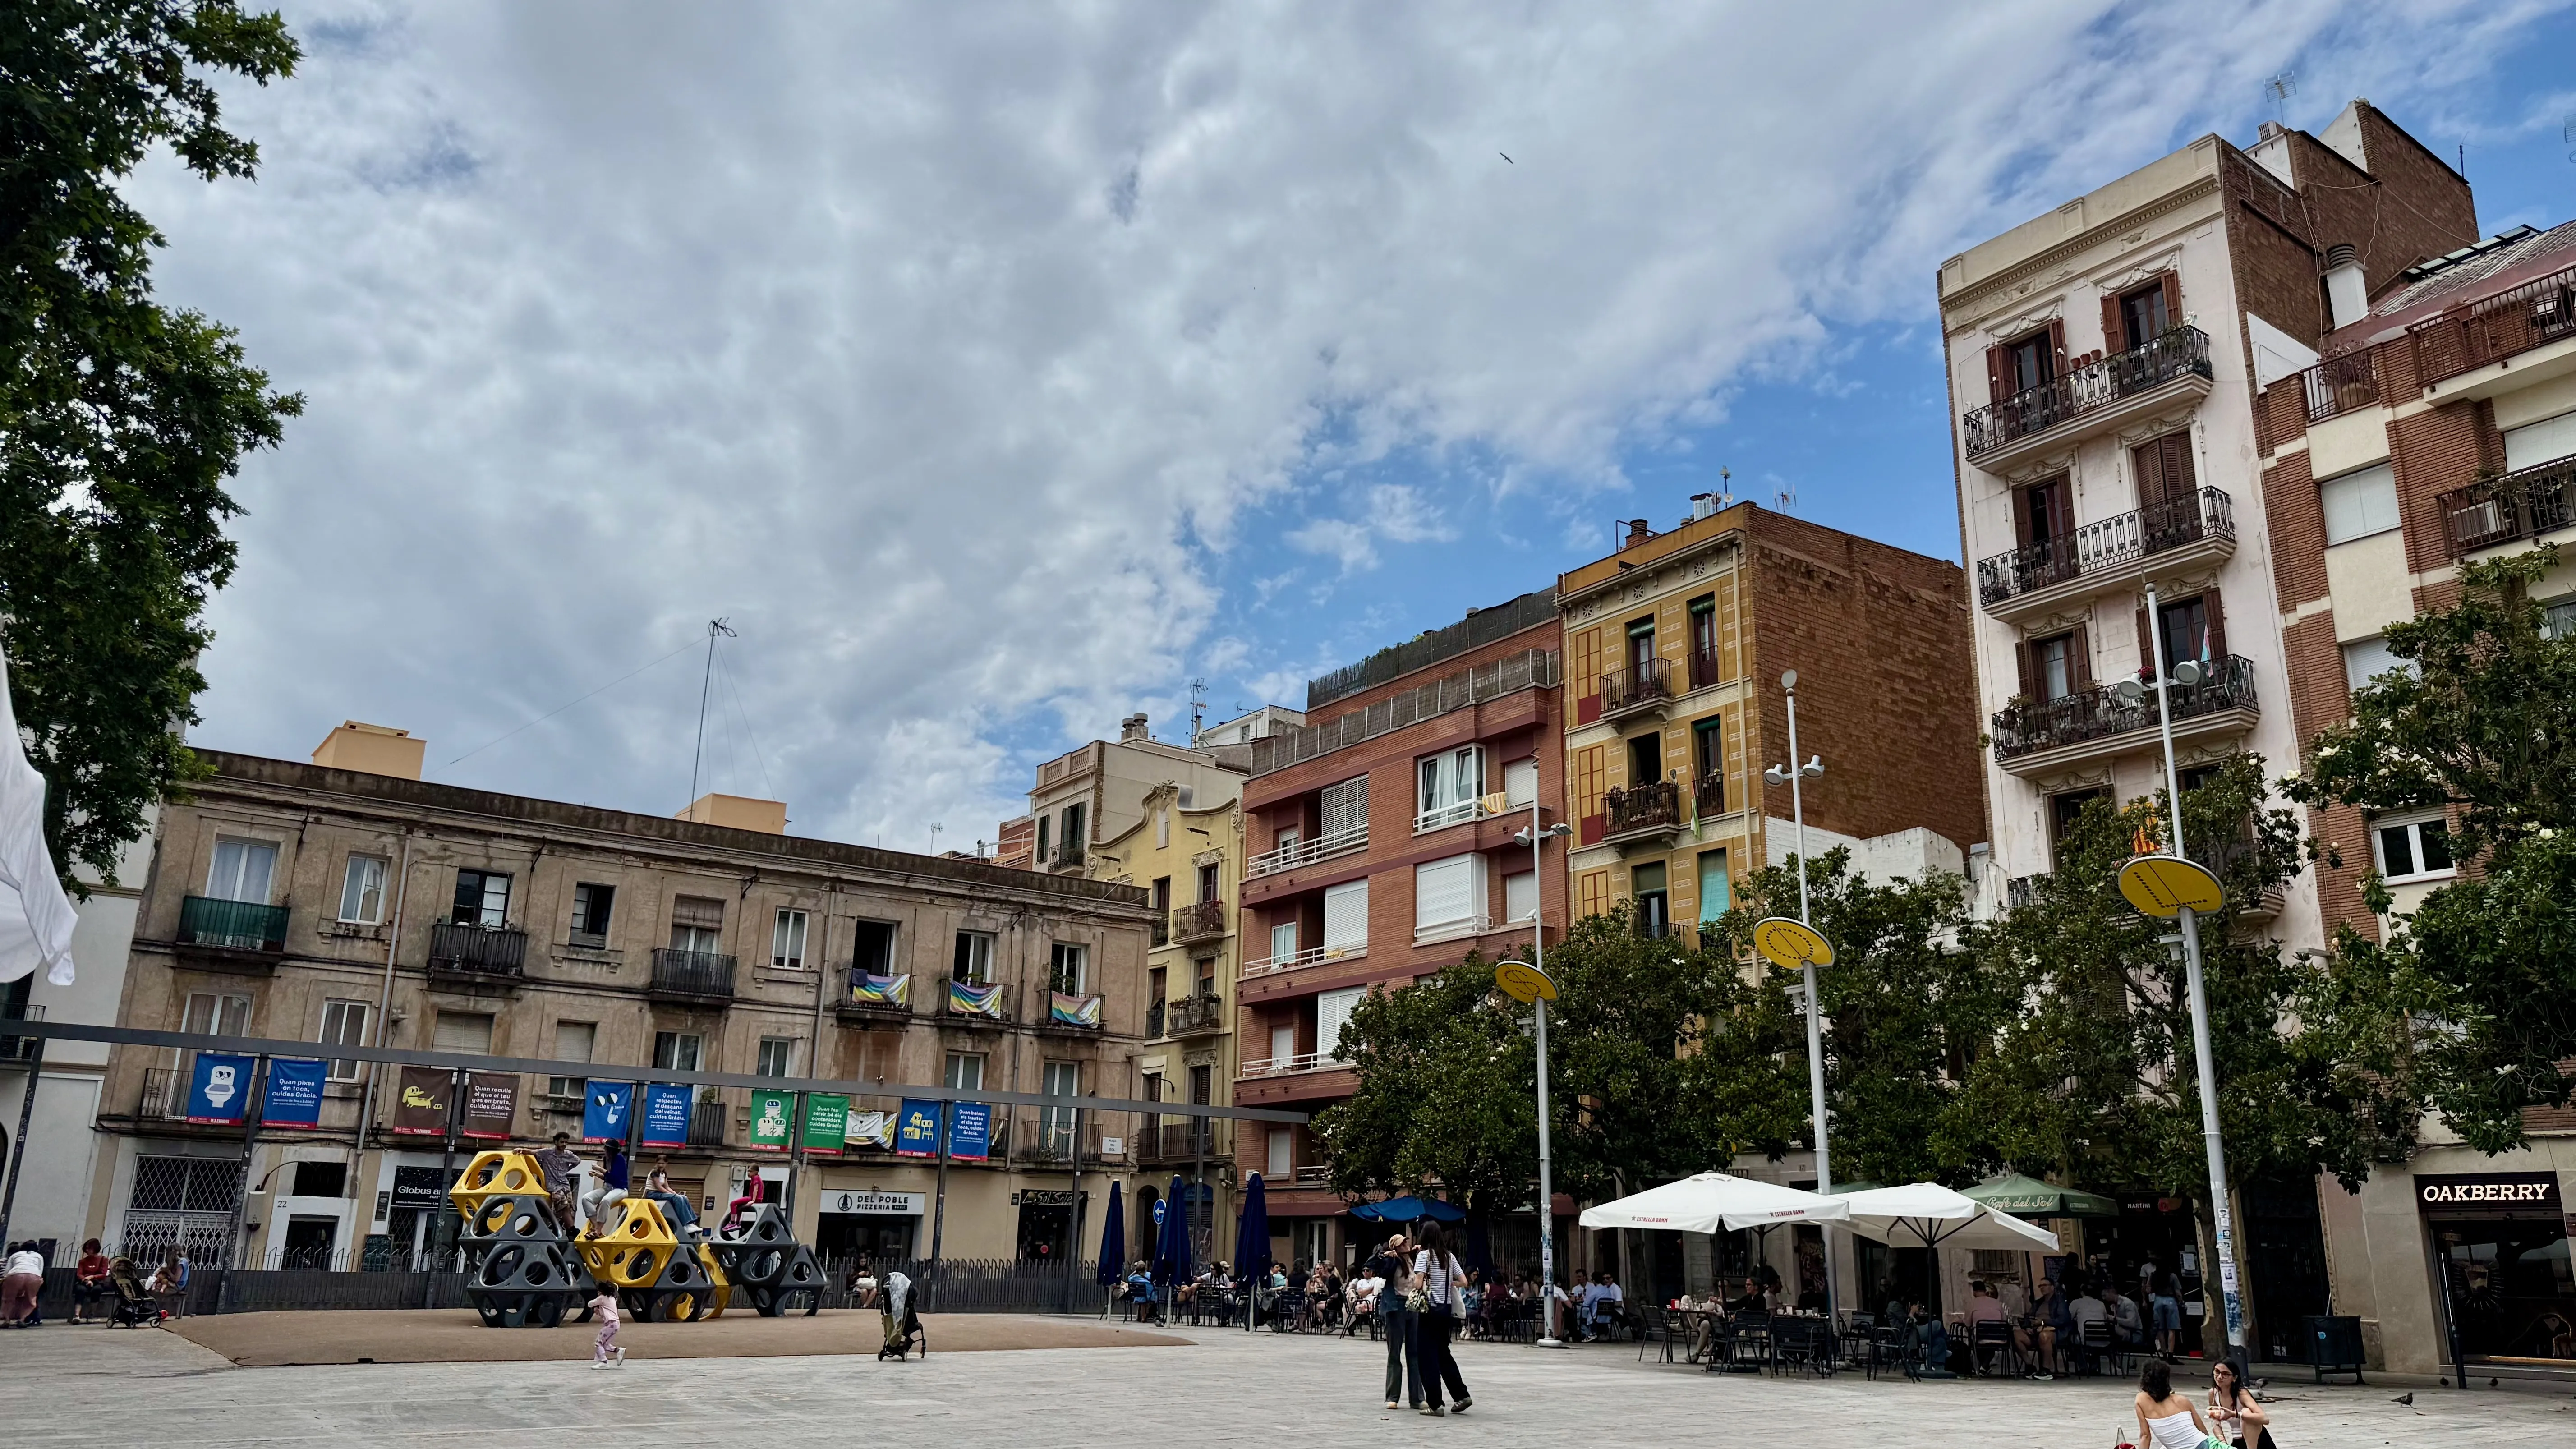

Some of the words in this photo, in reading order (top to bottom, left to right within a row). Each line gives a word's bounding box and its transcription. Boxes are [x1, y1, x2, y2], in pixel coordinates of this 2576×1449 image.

[398, 1186, 432, 1195] Globus
[2424, 1184, 2549, 1201] OAKBERRY
[2013, 1196, 2030, 1207] del
[2032, 1196, 2054, 1207] Sol
